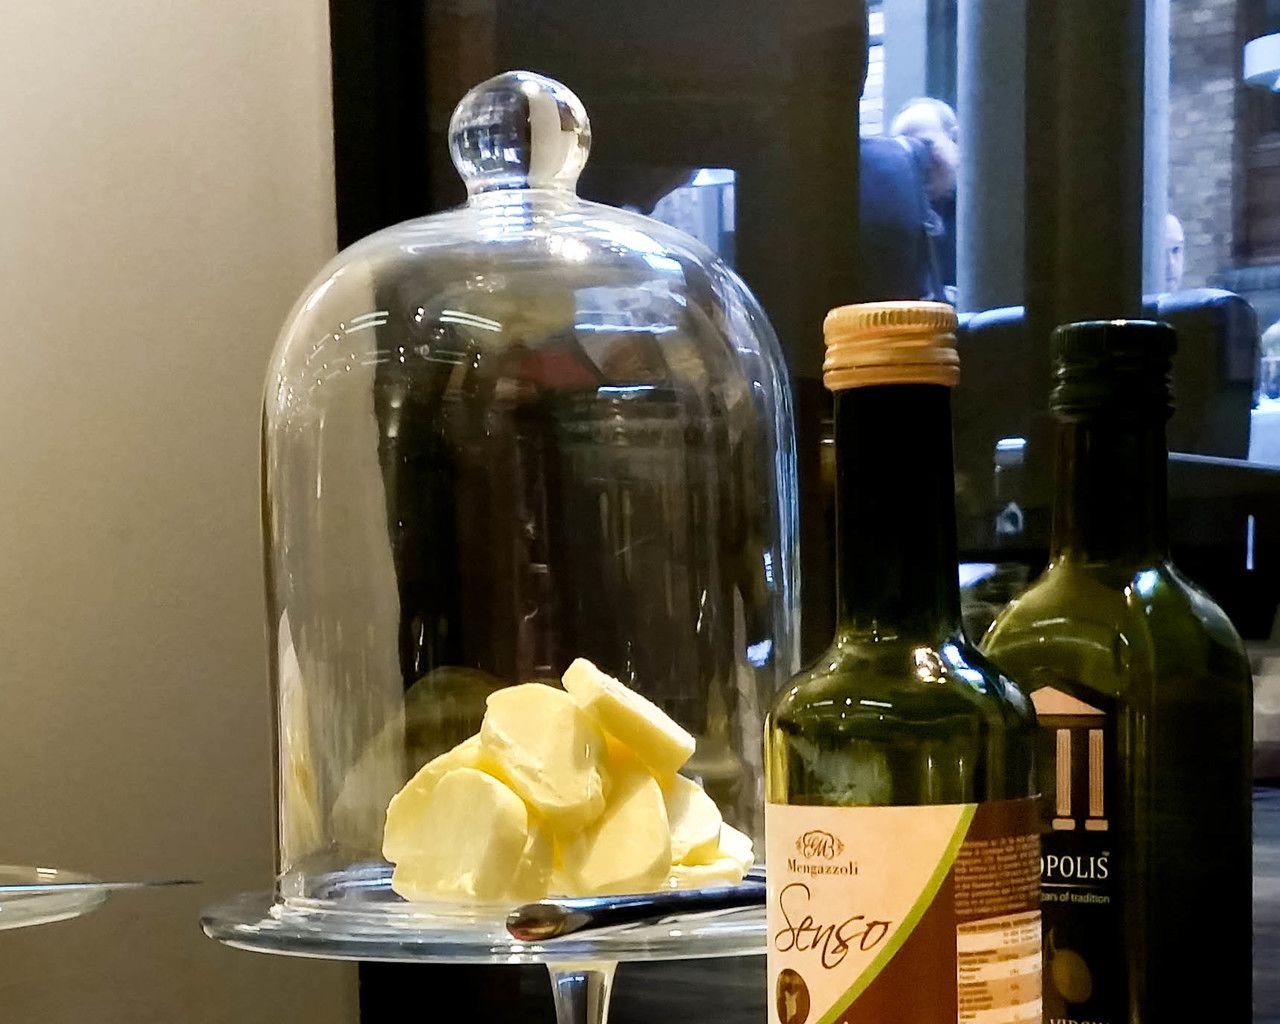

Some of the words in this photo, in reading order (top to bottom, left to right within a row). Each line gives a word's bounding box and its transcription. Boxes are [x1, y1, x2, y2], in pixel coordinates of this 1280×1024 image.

[787, 858, 858, 877] Mengazzoli
[1071, 892, 1110, 904] tradition
[775, 883, 892, 970] Senso
